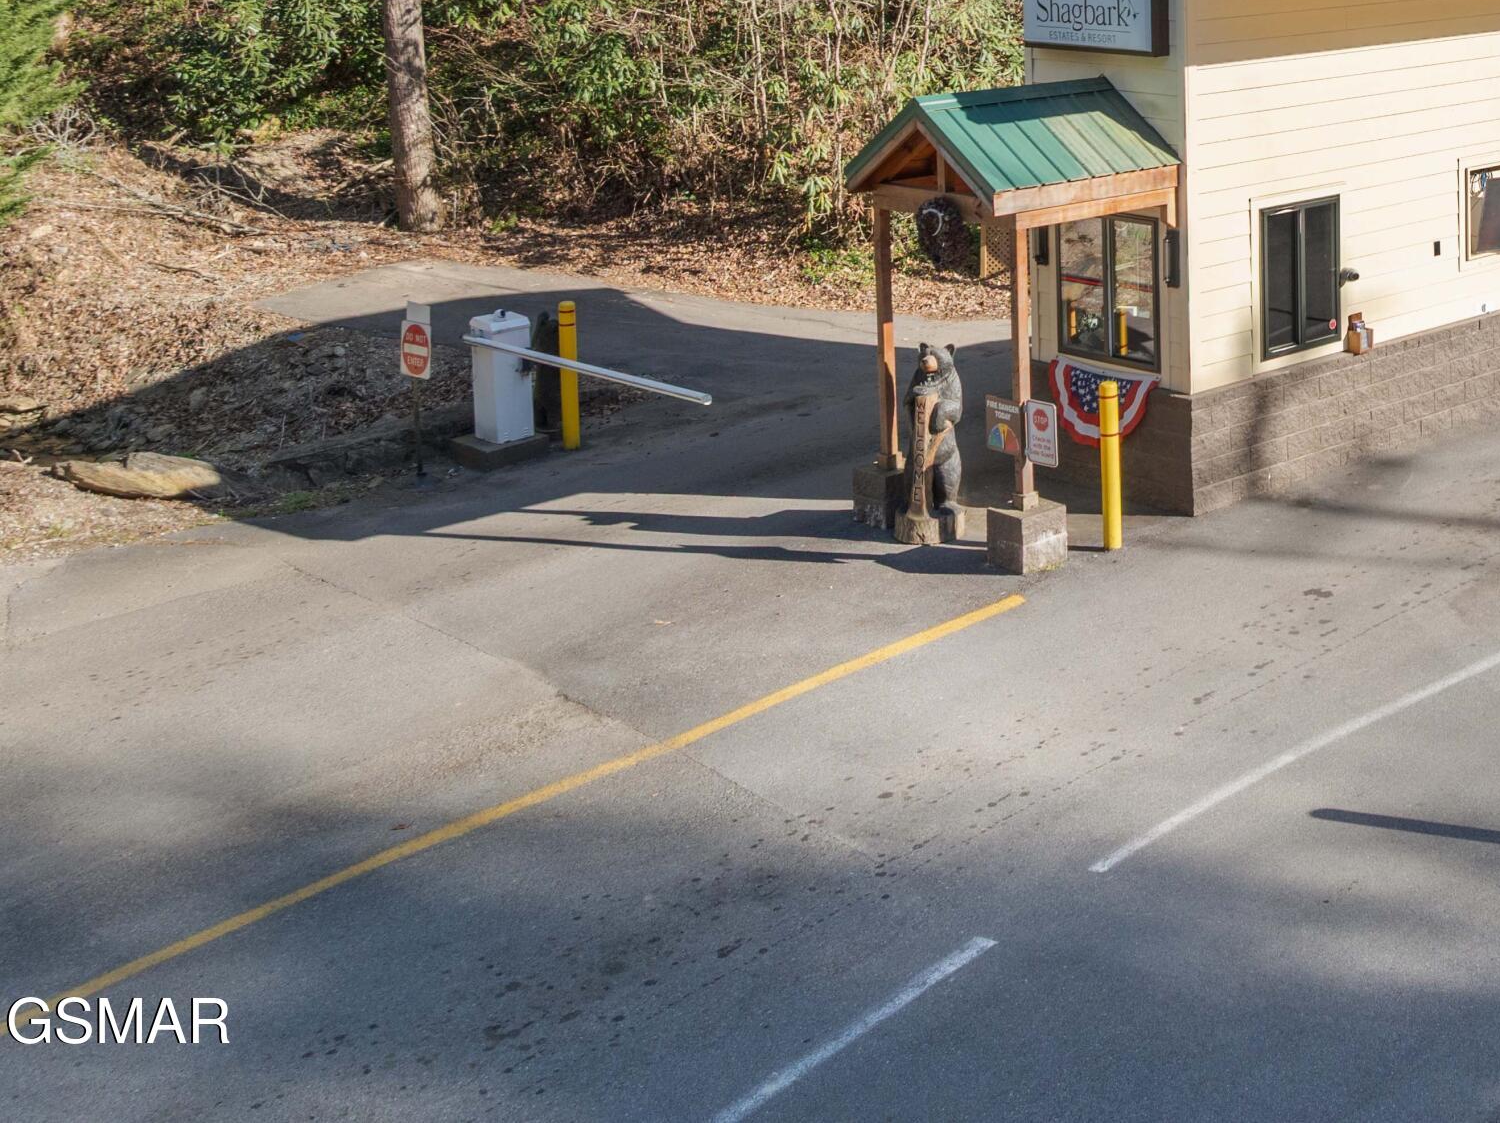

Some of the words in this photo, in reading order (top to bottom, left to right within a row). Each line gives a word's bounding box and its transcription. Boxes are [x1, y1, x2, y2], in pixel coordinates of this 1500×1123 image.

[1049, 30, 1079, 42] ESTATES
[1080, 33, 1087, 42] &
[1088, 33, 1117, 44] RESORT
[405, 332, 414, 342] DO
[415, 334, 426, 345] NOT
[407, 355, 425, 367] ENTER
[986, 399, 999, 410] FIRE
[999, 402, 1020, 414] DANGER
[994, 410, 1011, 421] TODAY
[1034, 414, 1048, 423] STOP
[914, 398, 926, 502] WELCOME
